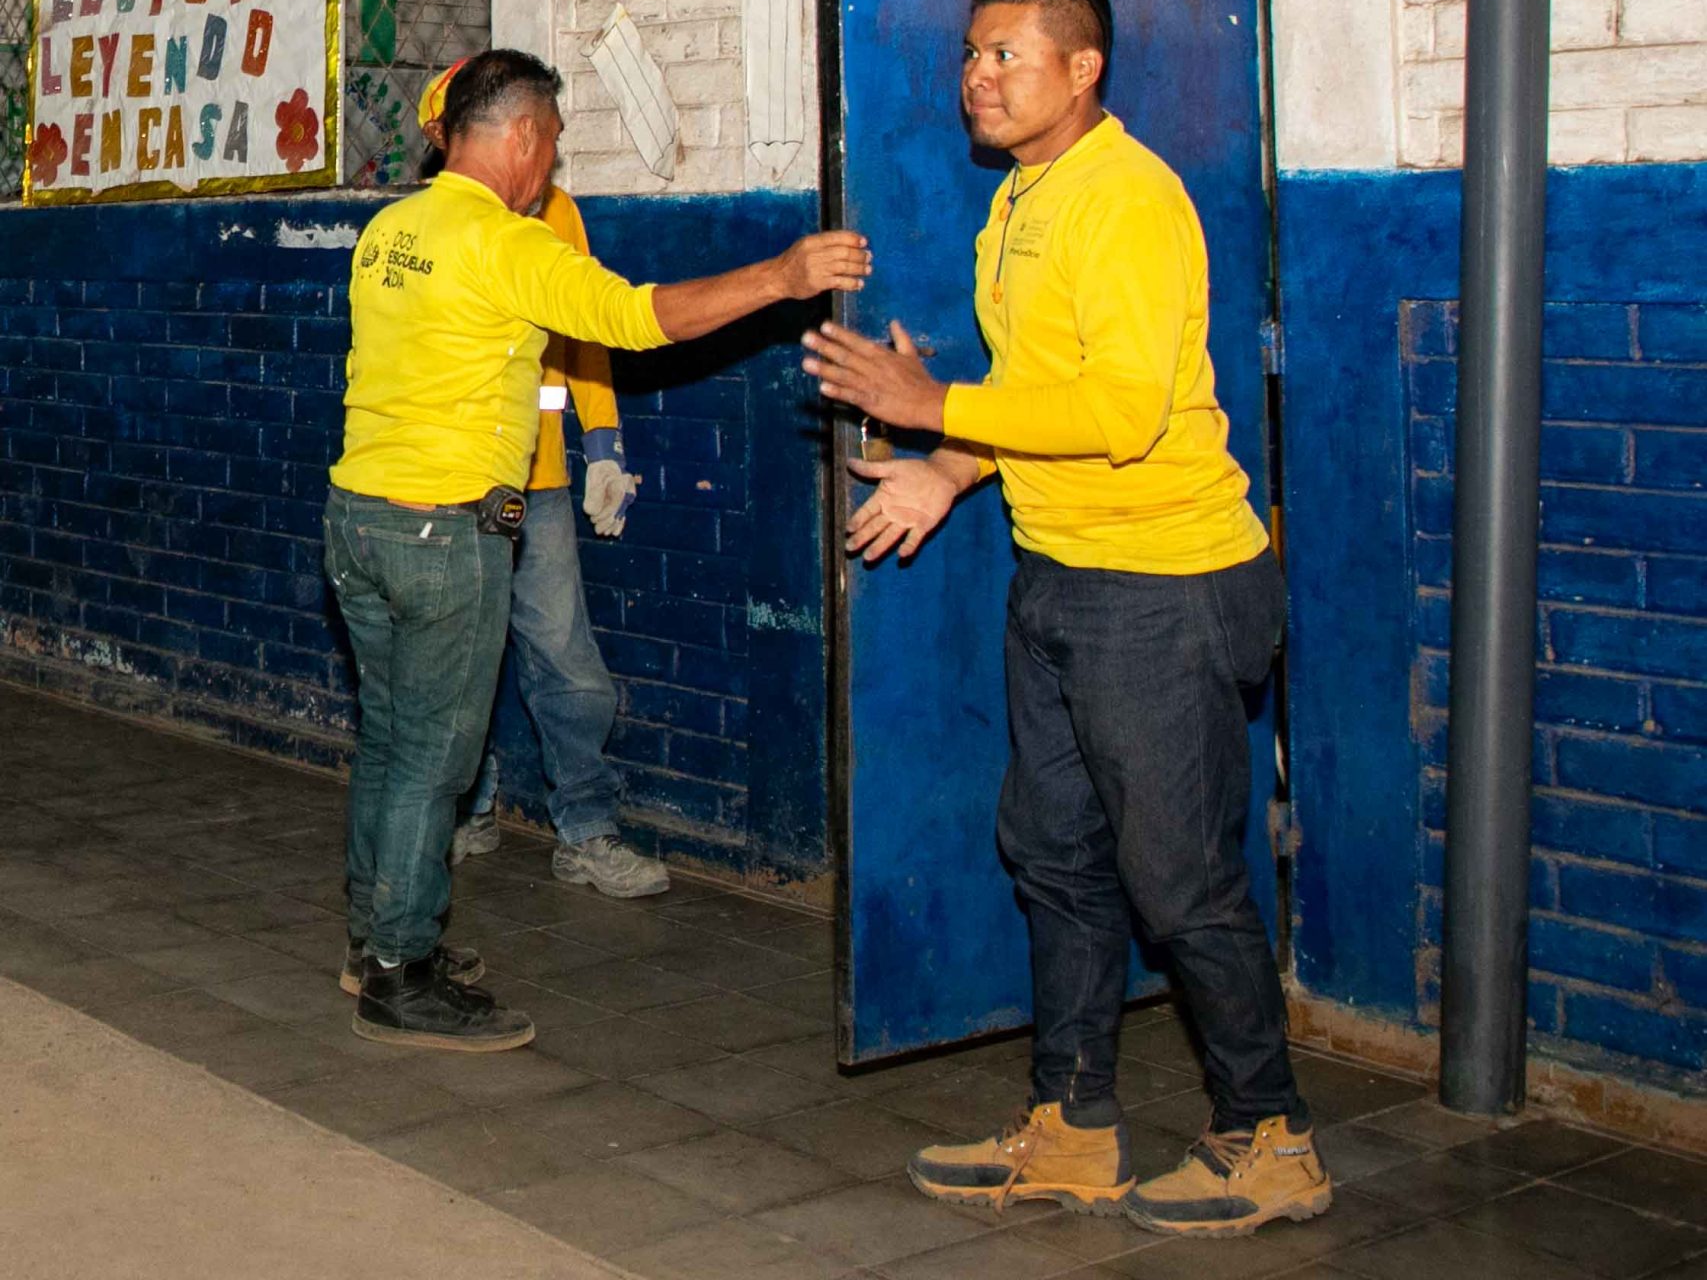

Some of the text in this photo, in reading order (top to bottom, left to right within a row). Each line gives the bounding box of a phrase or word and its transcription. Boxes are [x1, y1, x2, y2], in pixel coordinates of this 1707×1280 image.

[41, 9, 274, 98] LEYENDO
[71, 100, 249, 176] EN CASA
[387, 249, 434, 275] ESCUELAS
[392, 230, 418, 251] DOS
